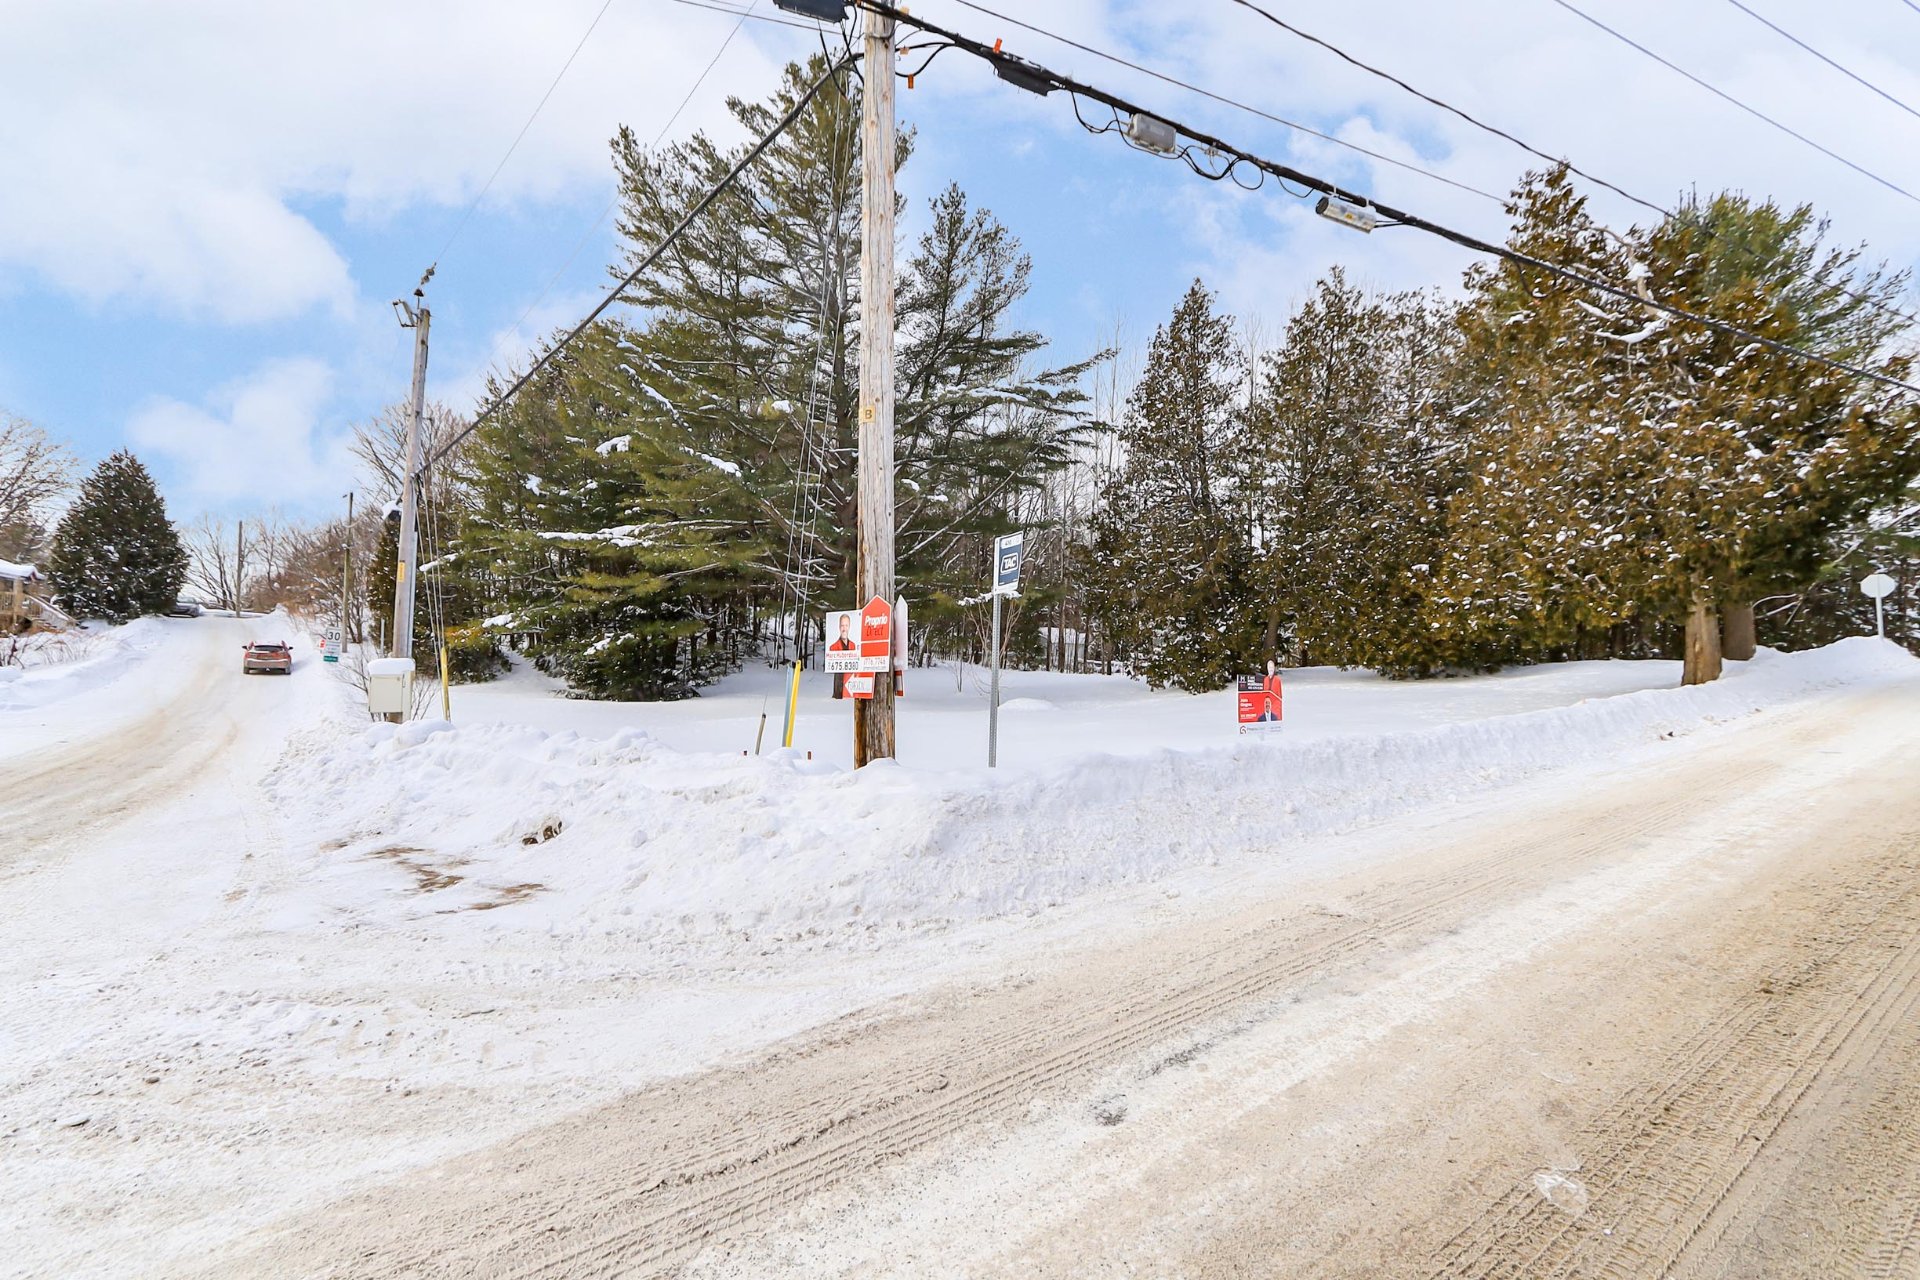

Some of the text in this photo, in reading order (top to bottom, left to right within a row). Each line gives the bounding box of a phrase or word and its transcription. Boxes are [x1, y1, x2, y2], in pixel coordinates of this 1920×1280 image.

[1004, 556, 1017, 569] TAC
[865, 614, 888, 628] Proprio
[328, 631, 341, 641] 30
